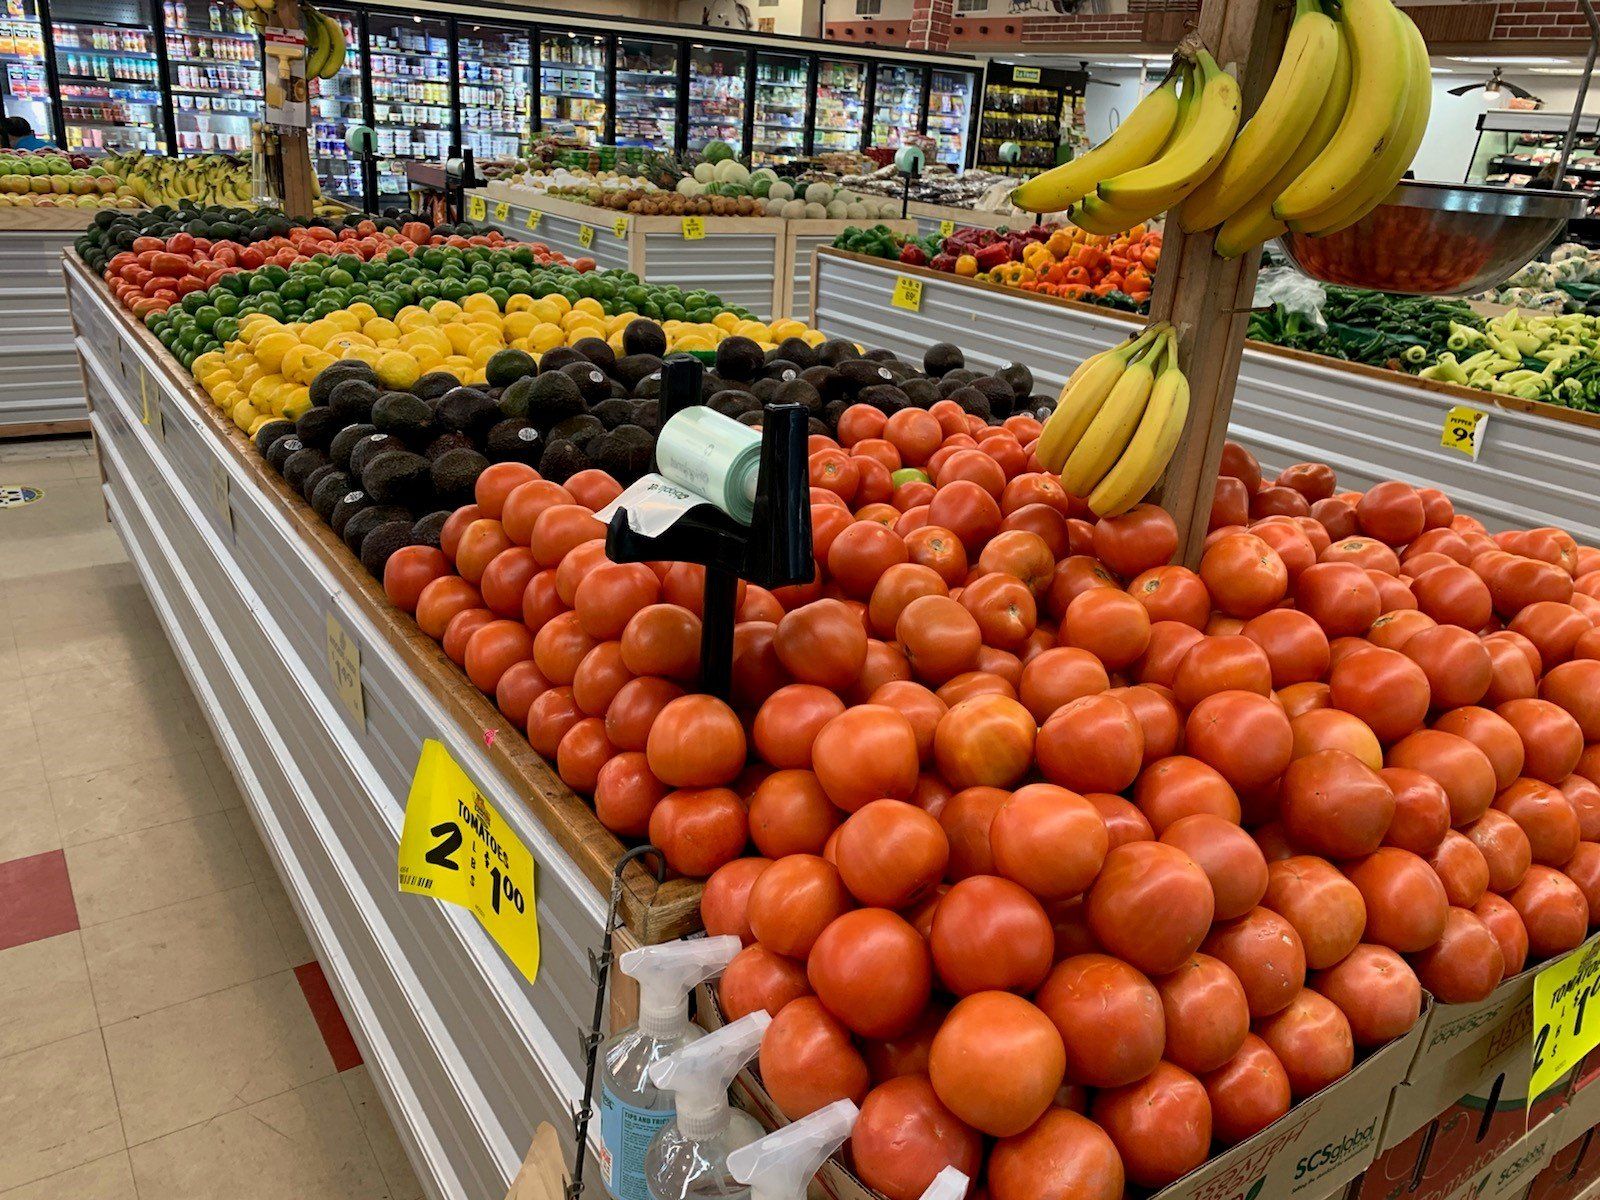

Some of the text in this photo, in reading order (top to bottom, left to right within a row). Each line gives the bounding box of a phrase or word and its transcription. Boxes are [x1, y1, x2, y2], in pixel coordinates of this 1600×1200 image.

[425, 821, 463, 871] 2
[458, 798, 509, 870] TOMATOES
[1293, 1115, 1378, 1181] SCSglobal
